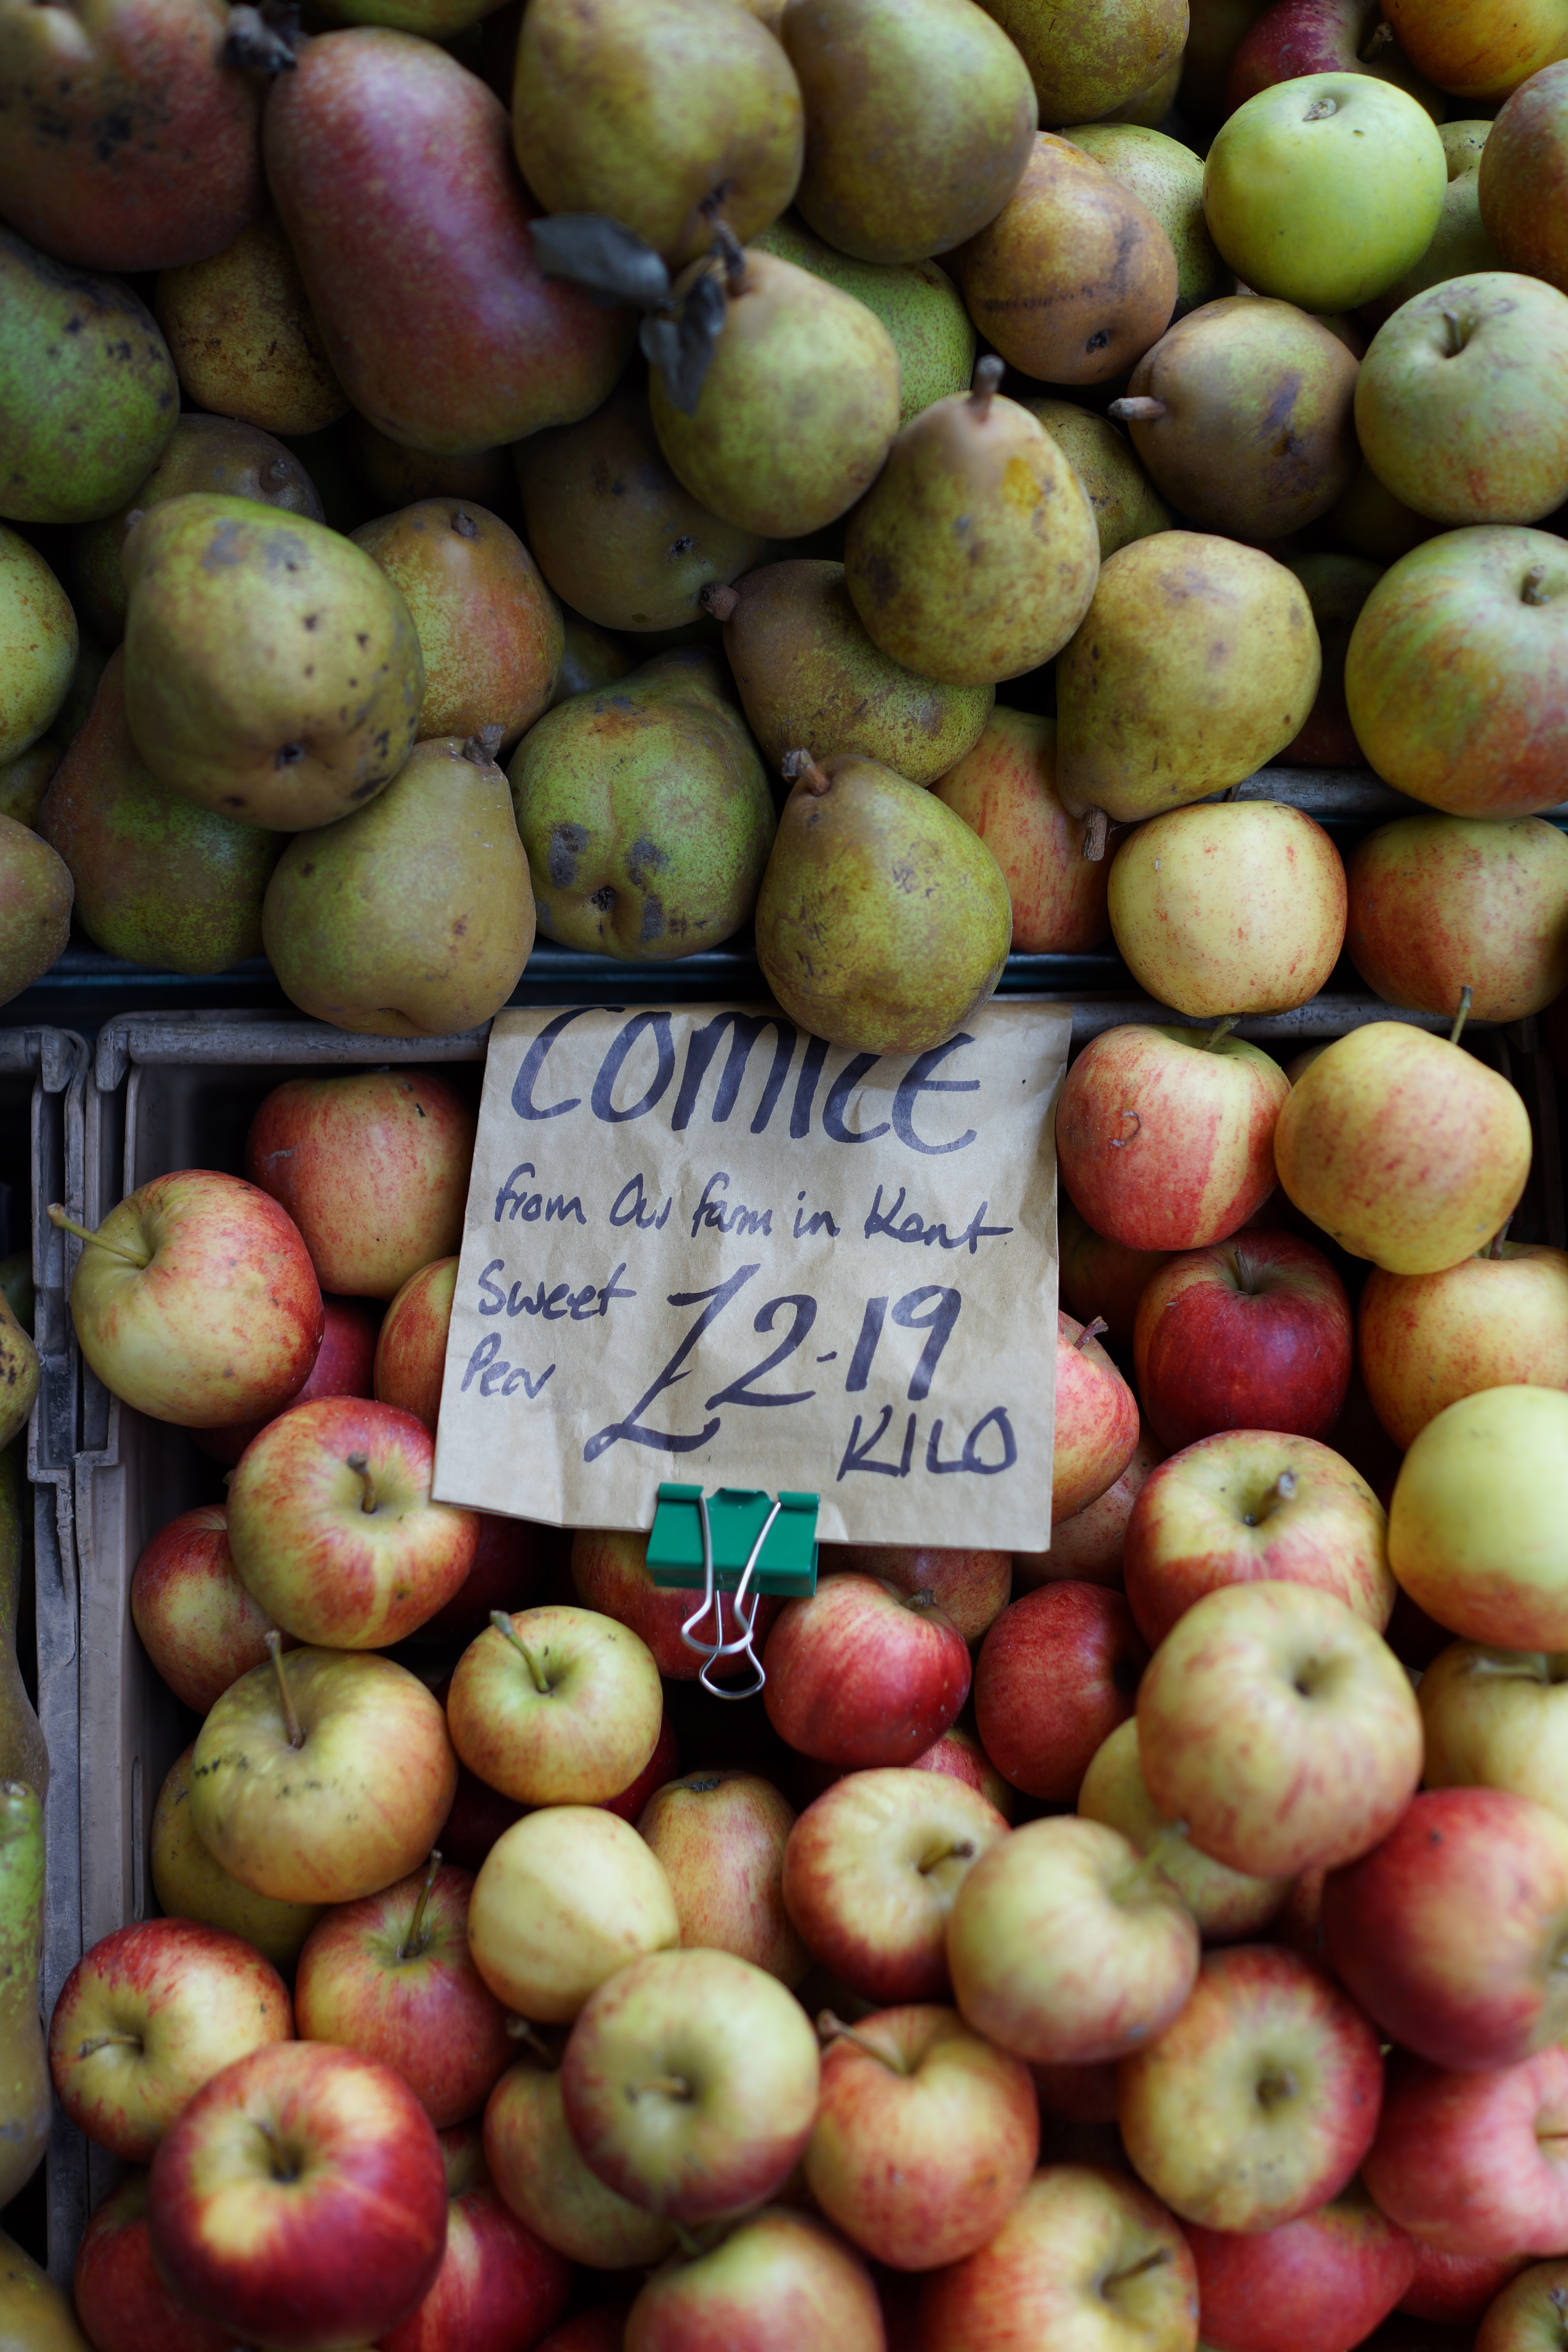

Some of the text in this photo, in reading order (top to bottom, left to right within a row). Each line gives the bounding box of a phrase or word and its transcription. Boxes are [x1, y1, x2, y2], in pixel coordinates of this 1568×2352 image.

[511, 1007, 980, 1155] COMICE
[495, 1162, 587, 1224] from
[692, 1172, 773, 1238] farm
[793, 1190, 840, 1238] in
[864, 1184, 1013, 1253] Kent
[478, 1259, 637, 1320] Sweet
[461, 1332, 556, 1399] Pear
[837, 1405, 1017, 1482] KILO
